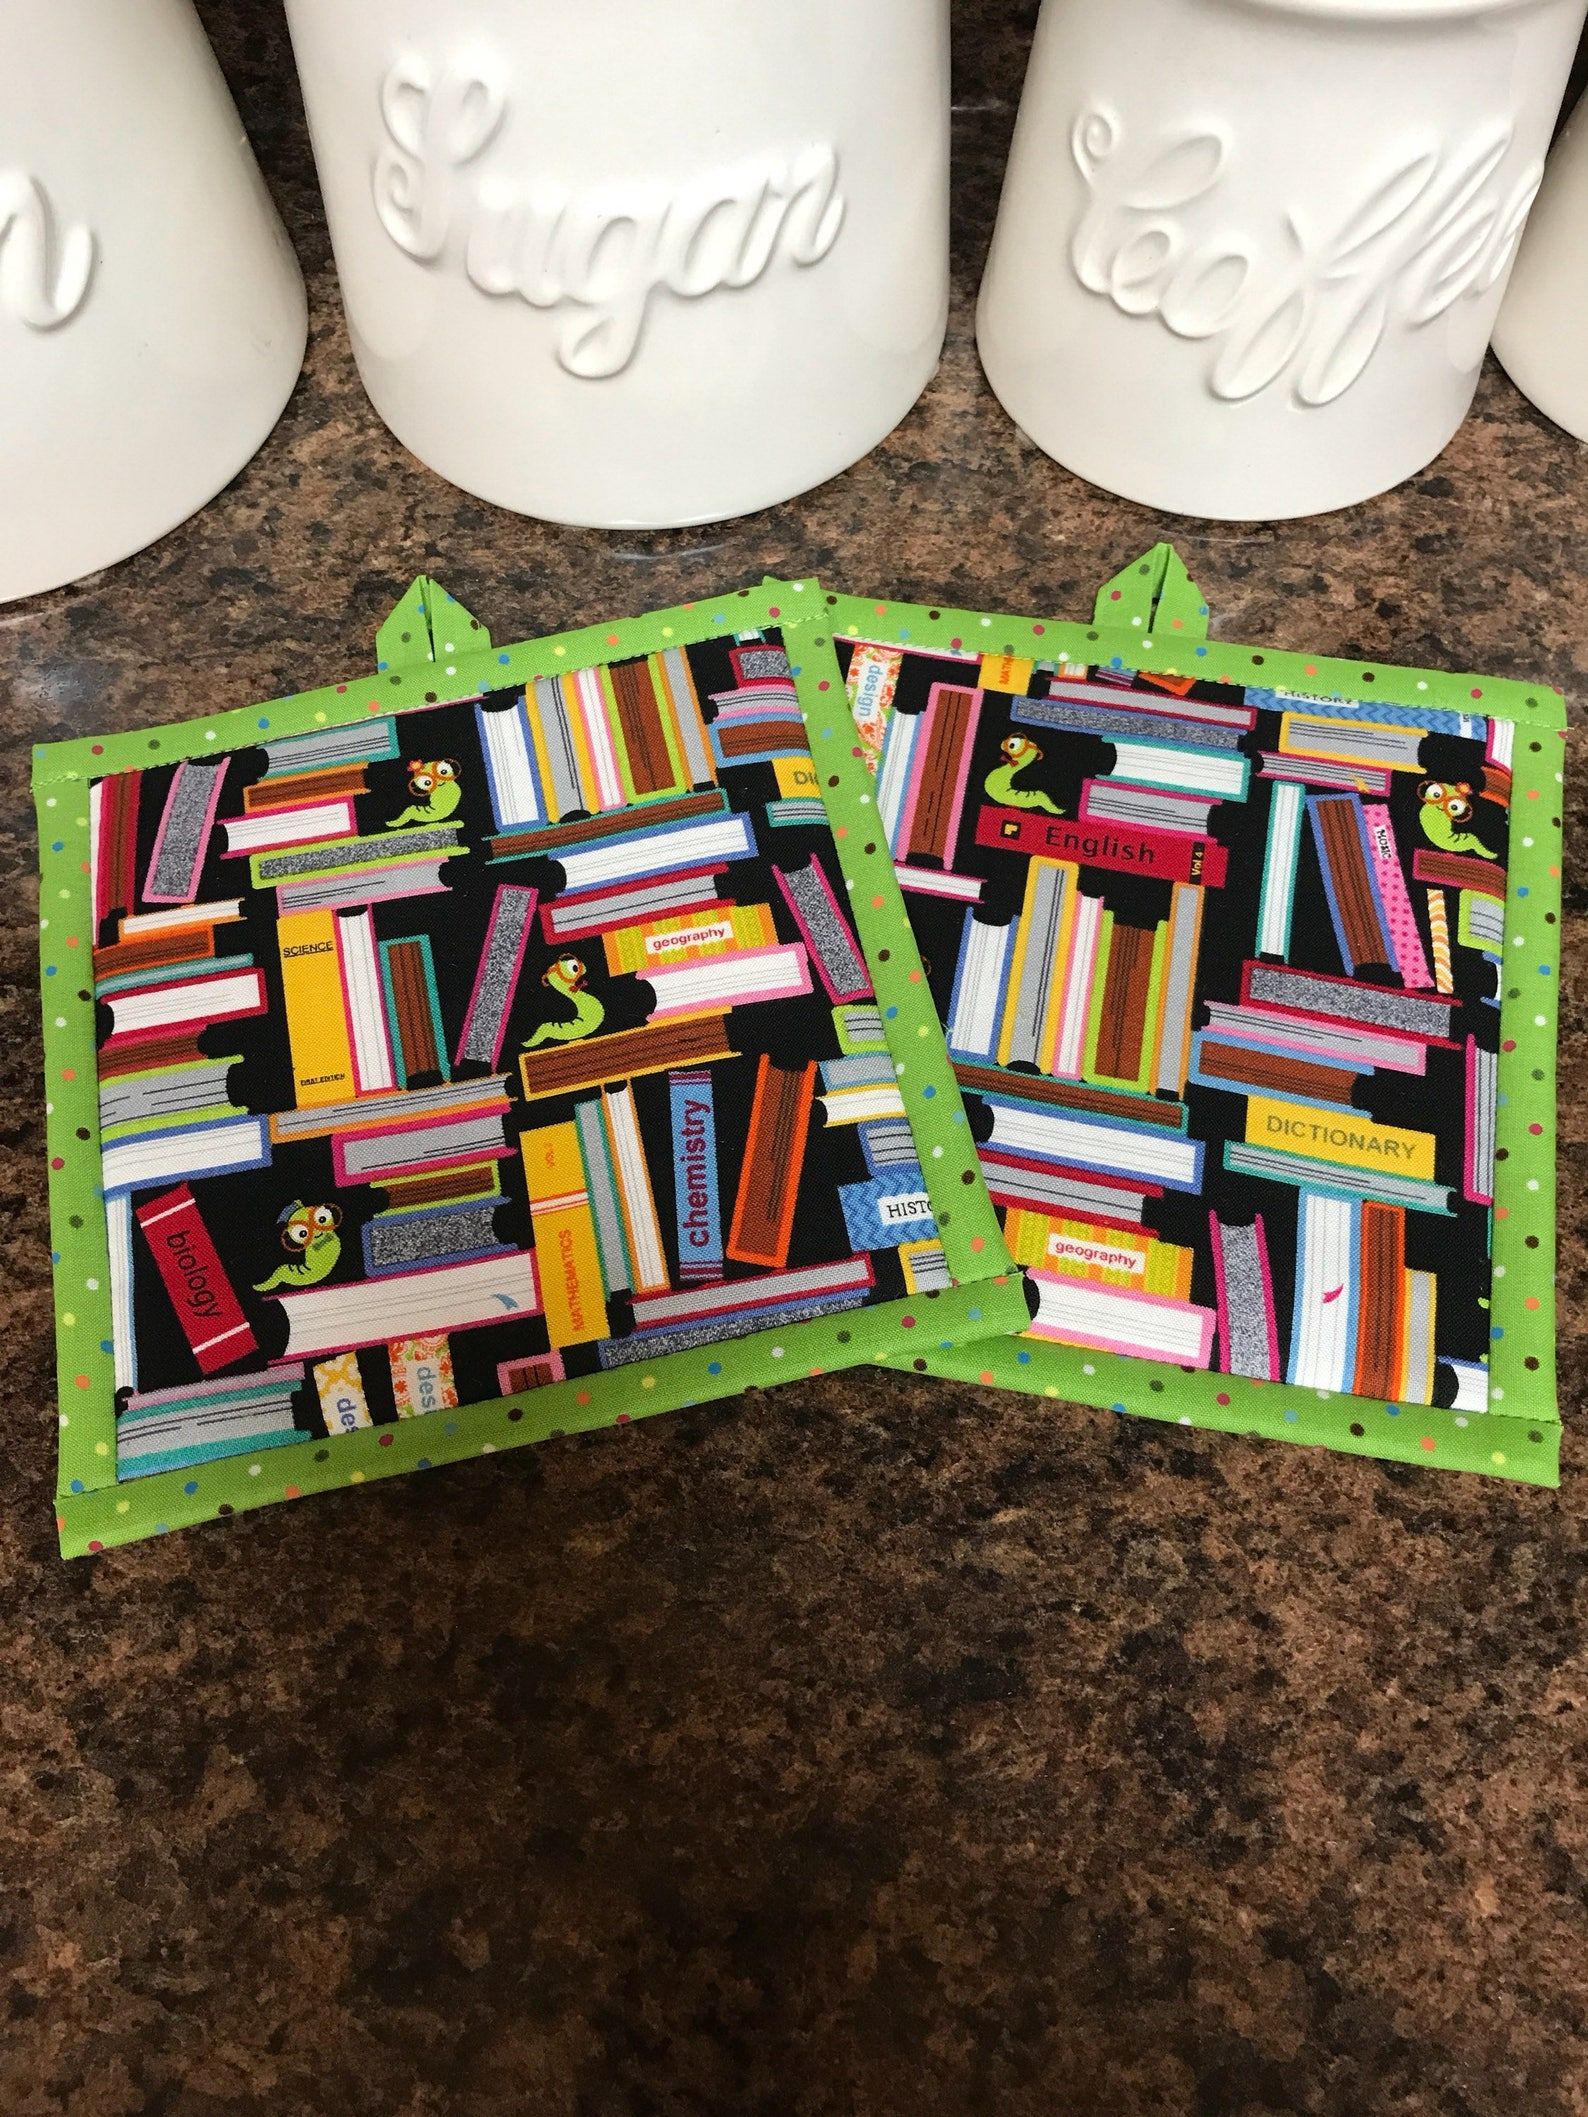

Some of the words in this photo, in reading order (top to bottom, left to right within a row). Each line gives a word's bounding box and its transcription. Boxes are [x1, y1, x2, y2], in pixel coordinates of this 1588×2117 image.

[372, 46, 846, 382] Sugar
[856, 665, 883, 717] design
[1045, 825, 1156, 865] English
[1191, 859, 1202, 876] Vol
[283, 940, 334, 958] SCIENCE
[653, 928, 725, 951] geography
[1266, 1114, 1417, 1160] DICTIONARY
[679, 1099, 711, 1248] chemistry
[166, 1230, 223, 1317] biology
[1055, 1242, 1137, 1269] geography
[558, 1229, 584, 1331] MATHEMATICS
[416, 1366, 437, 1414] des
[336, 1398, 360, 1434] de
